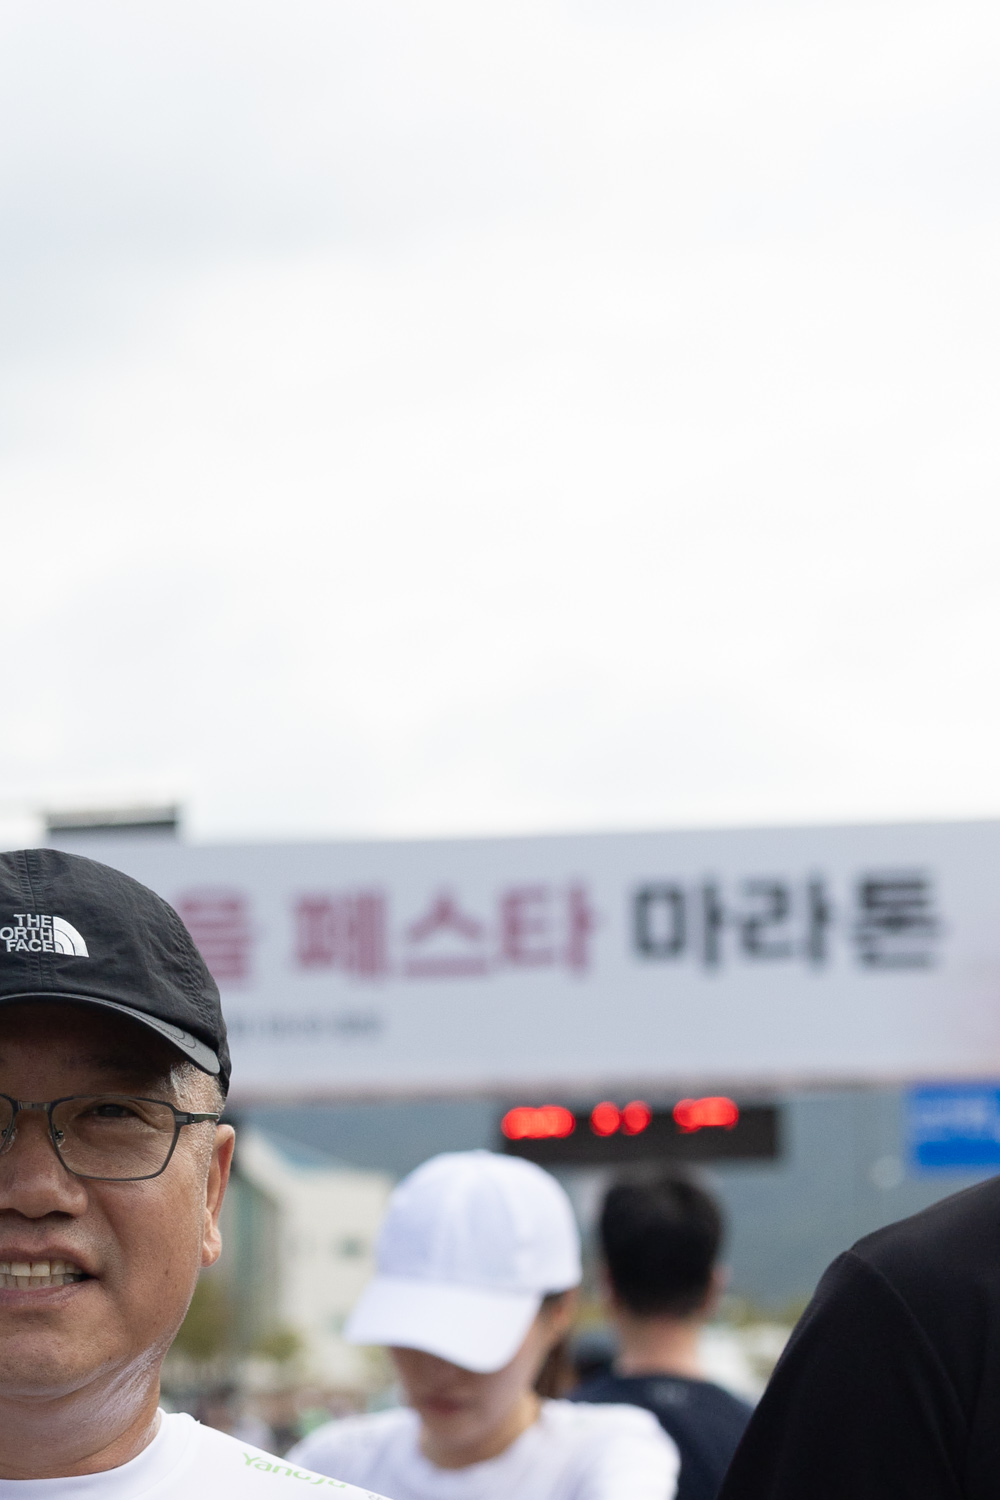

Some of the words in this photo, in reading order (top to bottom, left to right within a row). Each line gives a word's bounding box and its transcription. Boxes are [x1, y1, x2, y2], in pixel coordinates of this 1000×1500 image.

[13, 913, 53, 929] THE
[628, 870, 943, 974] 마라톤
[6, 939, 55, 953] FACE
